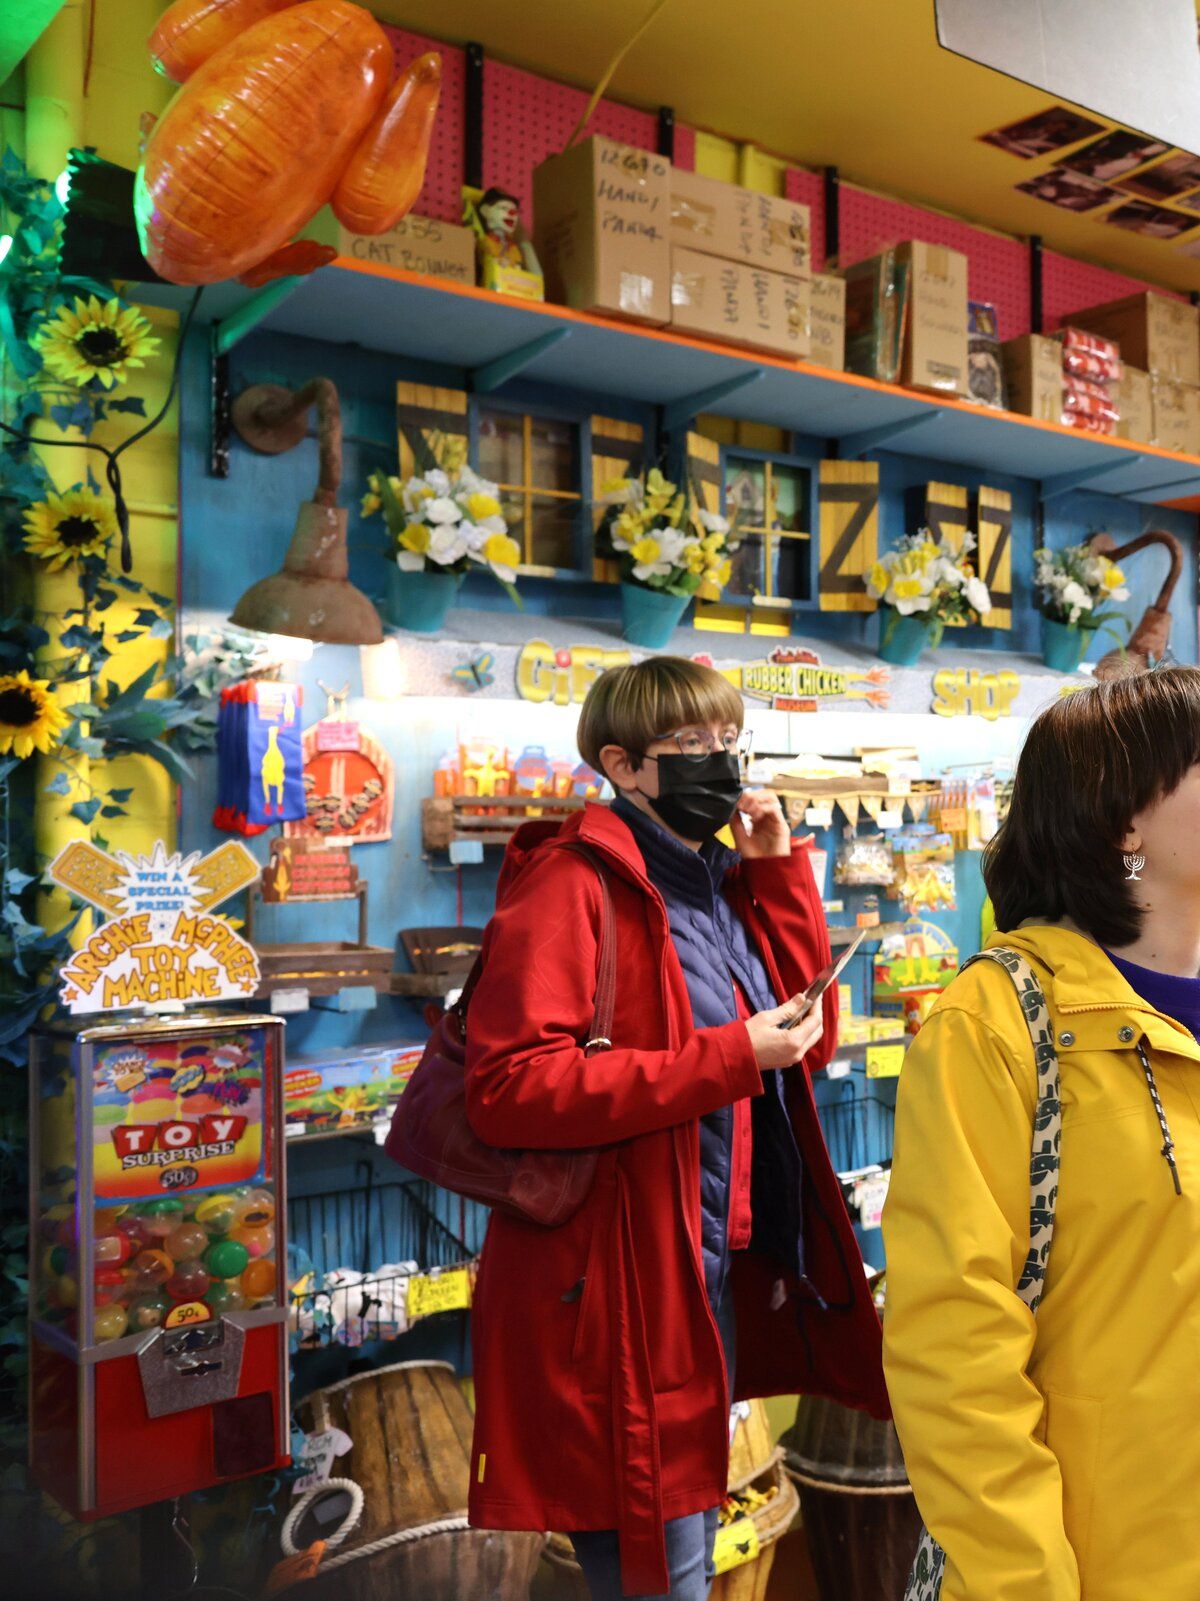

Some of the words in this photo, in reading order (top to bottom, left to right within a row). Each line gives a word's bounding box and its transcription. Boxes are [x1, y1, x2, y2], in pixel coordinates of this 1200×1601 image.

[352, 238, 394, 263] CAT
[746, 666, 793, 695] RUBBER
[797, 667, 846, 696] CHICKEN
[933, 669, 1021, 721] SHOP
[128, 886, 192, 897] SPECIAL
[136, 871, 167, 882] WIN
[172, 871, 182, 882] A
[130, 944, 196, 976] TOY
[125, 1119, 235, 1151] TOY
[122, 1140, 235, 1170] SURPRISE
